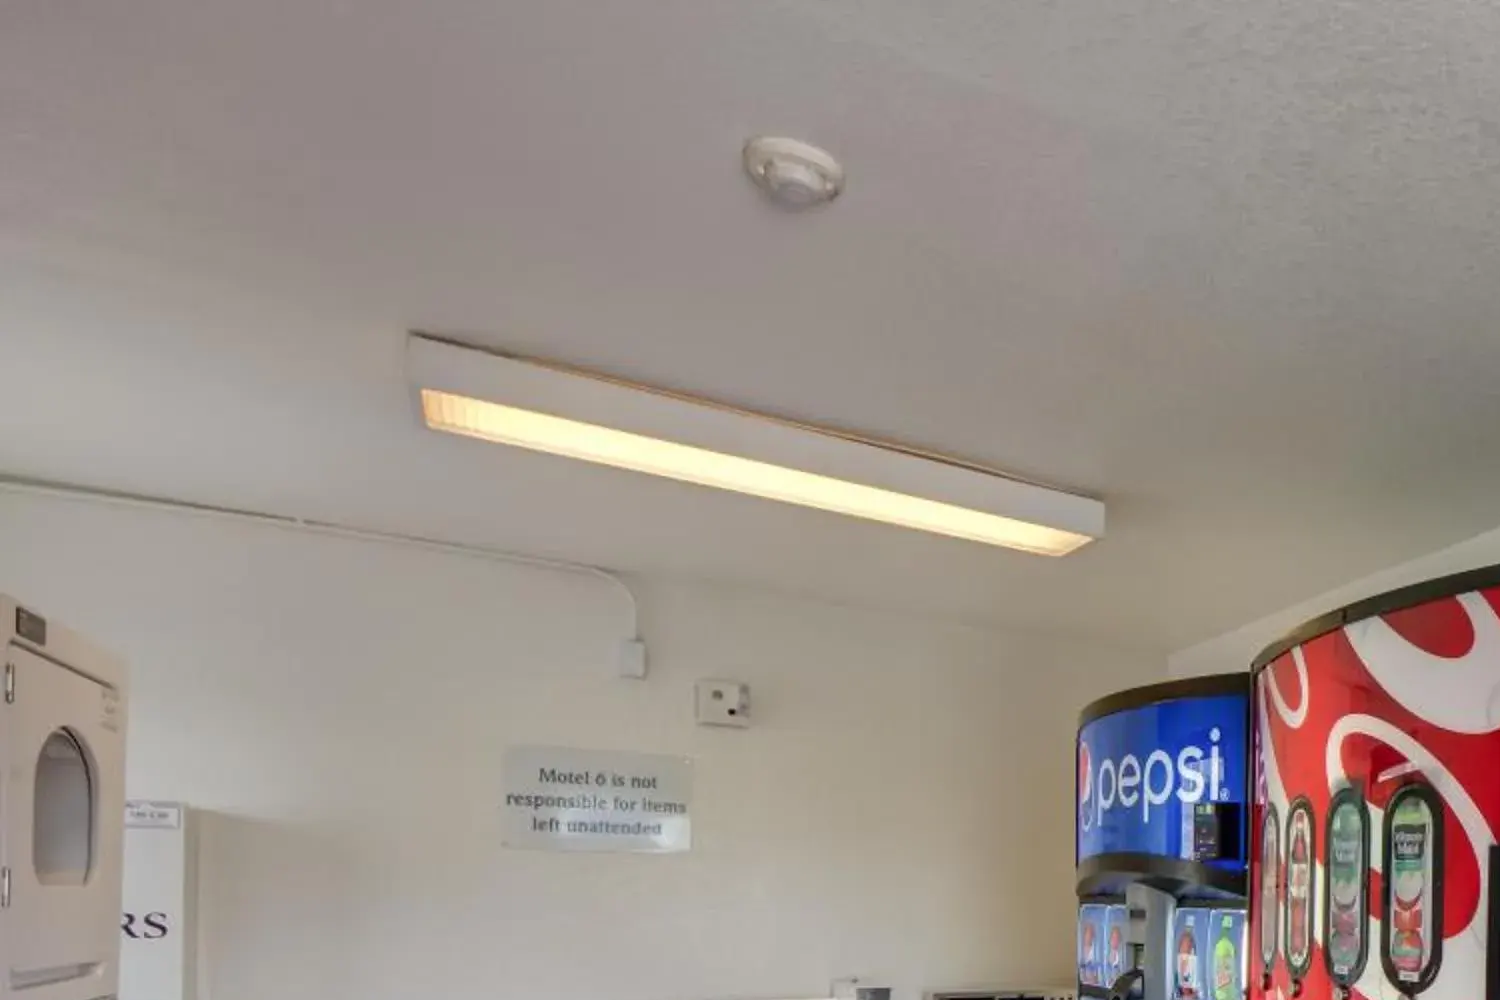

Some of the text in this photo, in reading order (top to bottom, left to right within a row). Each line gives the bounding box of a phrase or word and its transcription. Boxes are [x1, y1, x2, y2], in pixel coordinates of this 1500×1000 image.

[538, 767, 658, 790] Motel 6 is not
[1097, 726, 1221, 828] pepsi
[506, 792, 687, 815] responsible for items
[532, 815, 663, 836] left unattended
